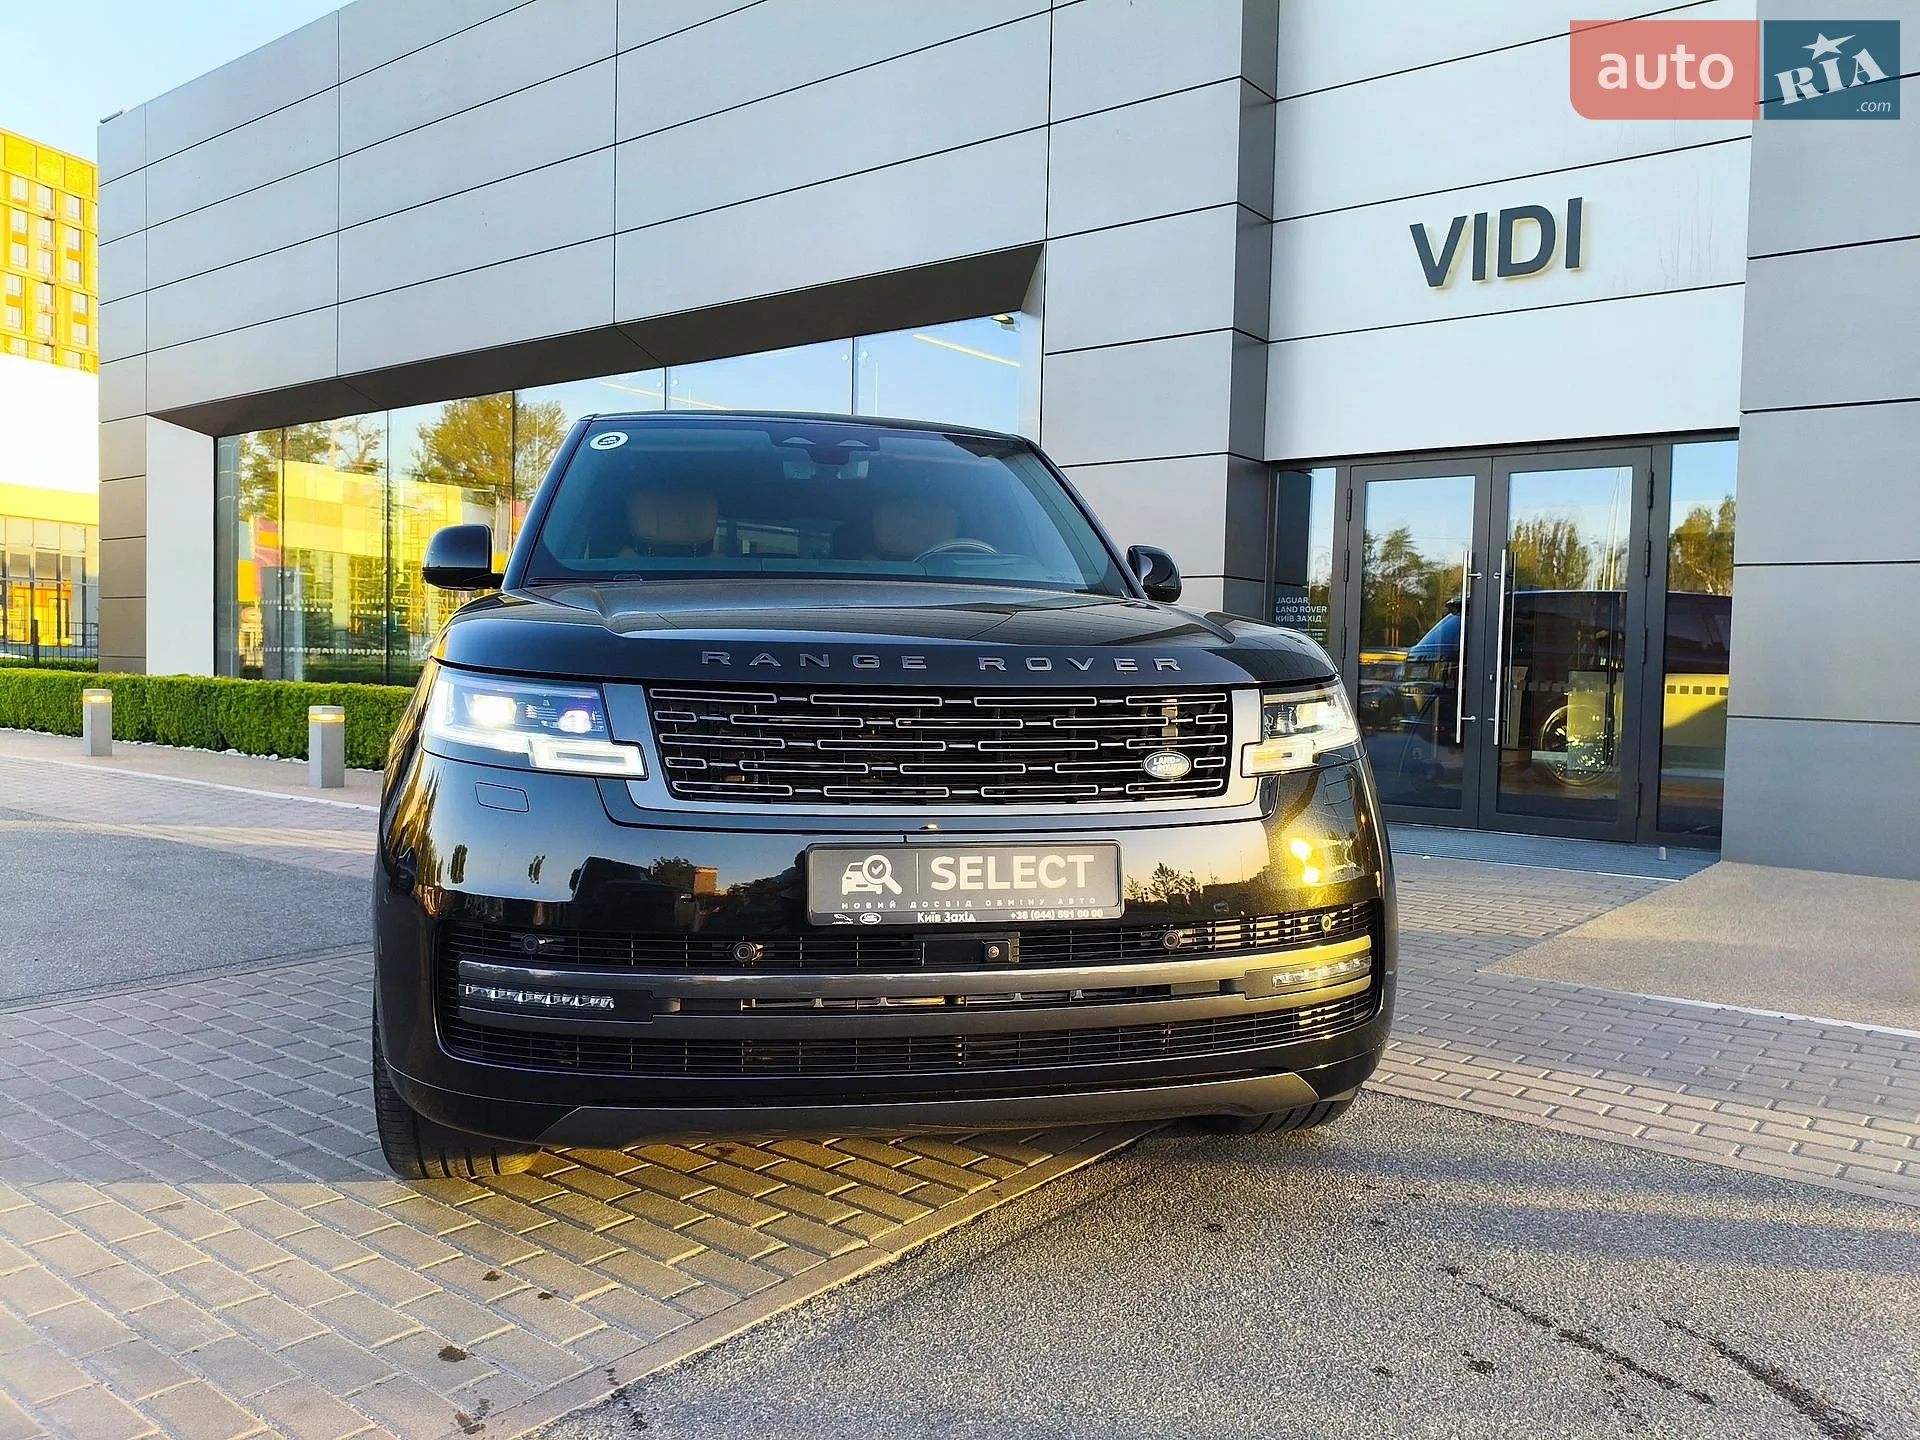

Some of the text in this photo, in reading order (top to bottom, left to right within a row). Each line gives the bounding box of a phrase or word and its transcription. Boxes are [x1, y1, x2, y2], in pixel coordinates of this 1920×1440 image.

[1409, 196, 1584, 288] VIDI
[1276, 596, 1309, 604] JAGUAR
[1275, 613, 1322, 623] КИЇВ ЗАХІД
[701, 650, 1183, 673] RANGE ROVER
[1153, 756, 1176, 765] LAND
[930, 854, 1095, 891] SELECT
[841, 897, 1096, 910] НОВИЙ ДОСВІД ОБМІНУ АВТО
[917, 911, 941, 923] Київ
[1010, 911, 1029, 920] +38
